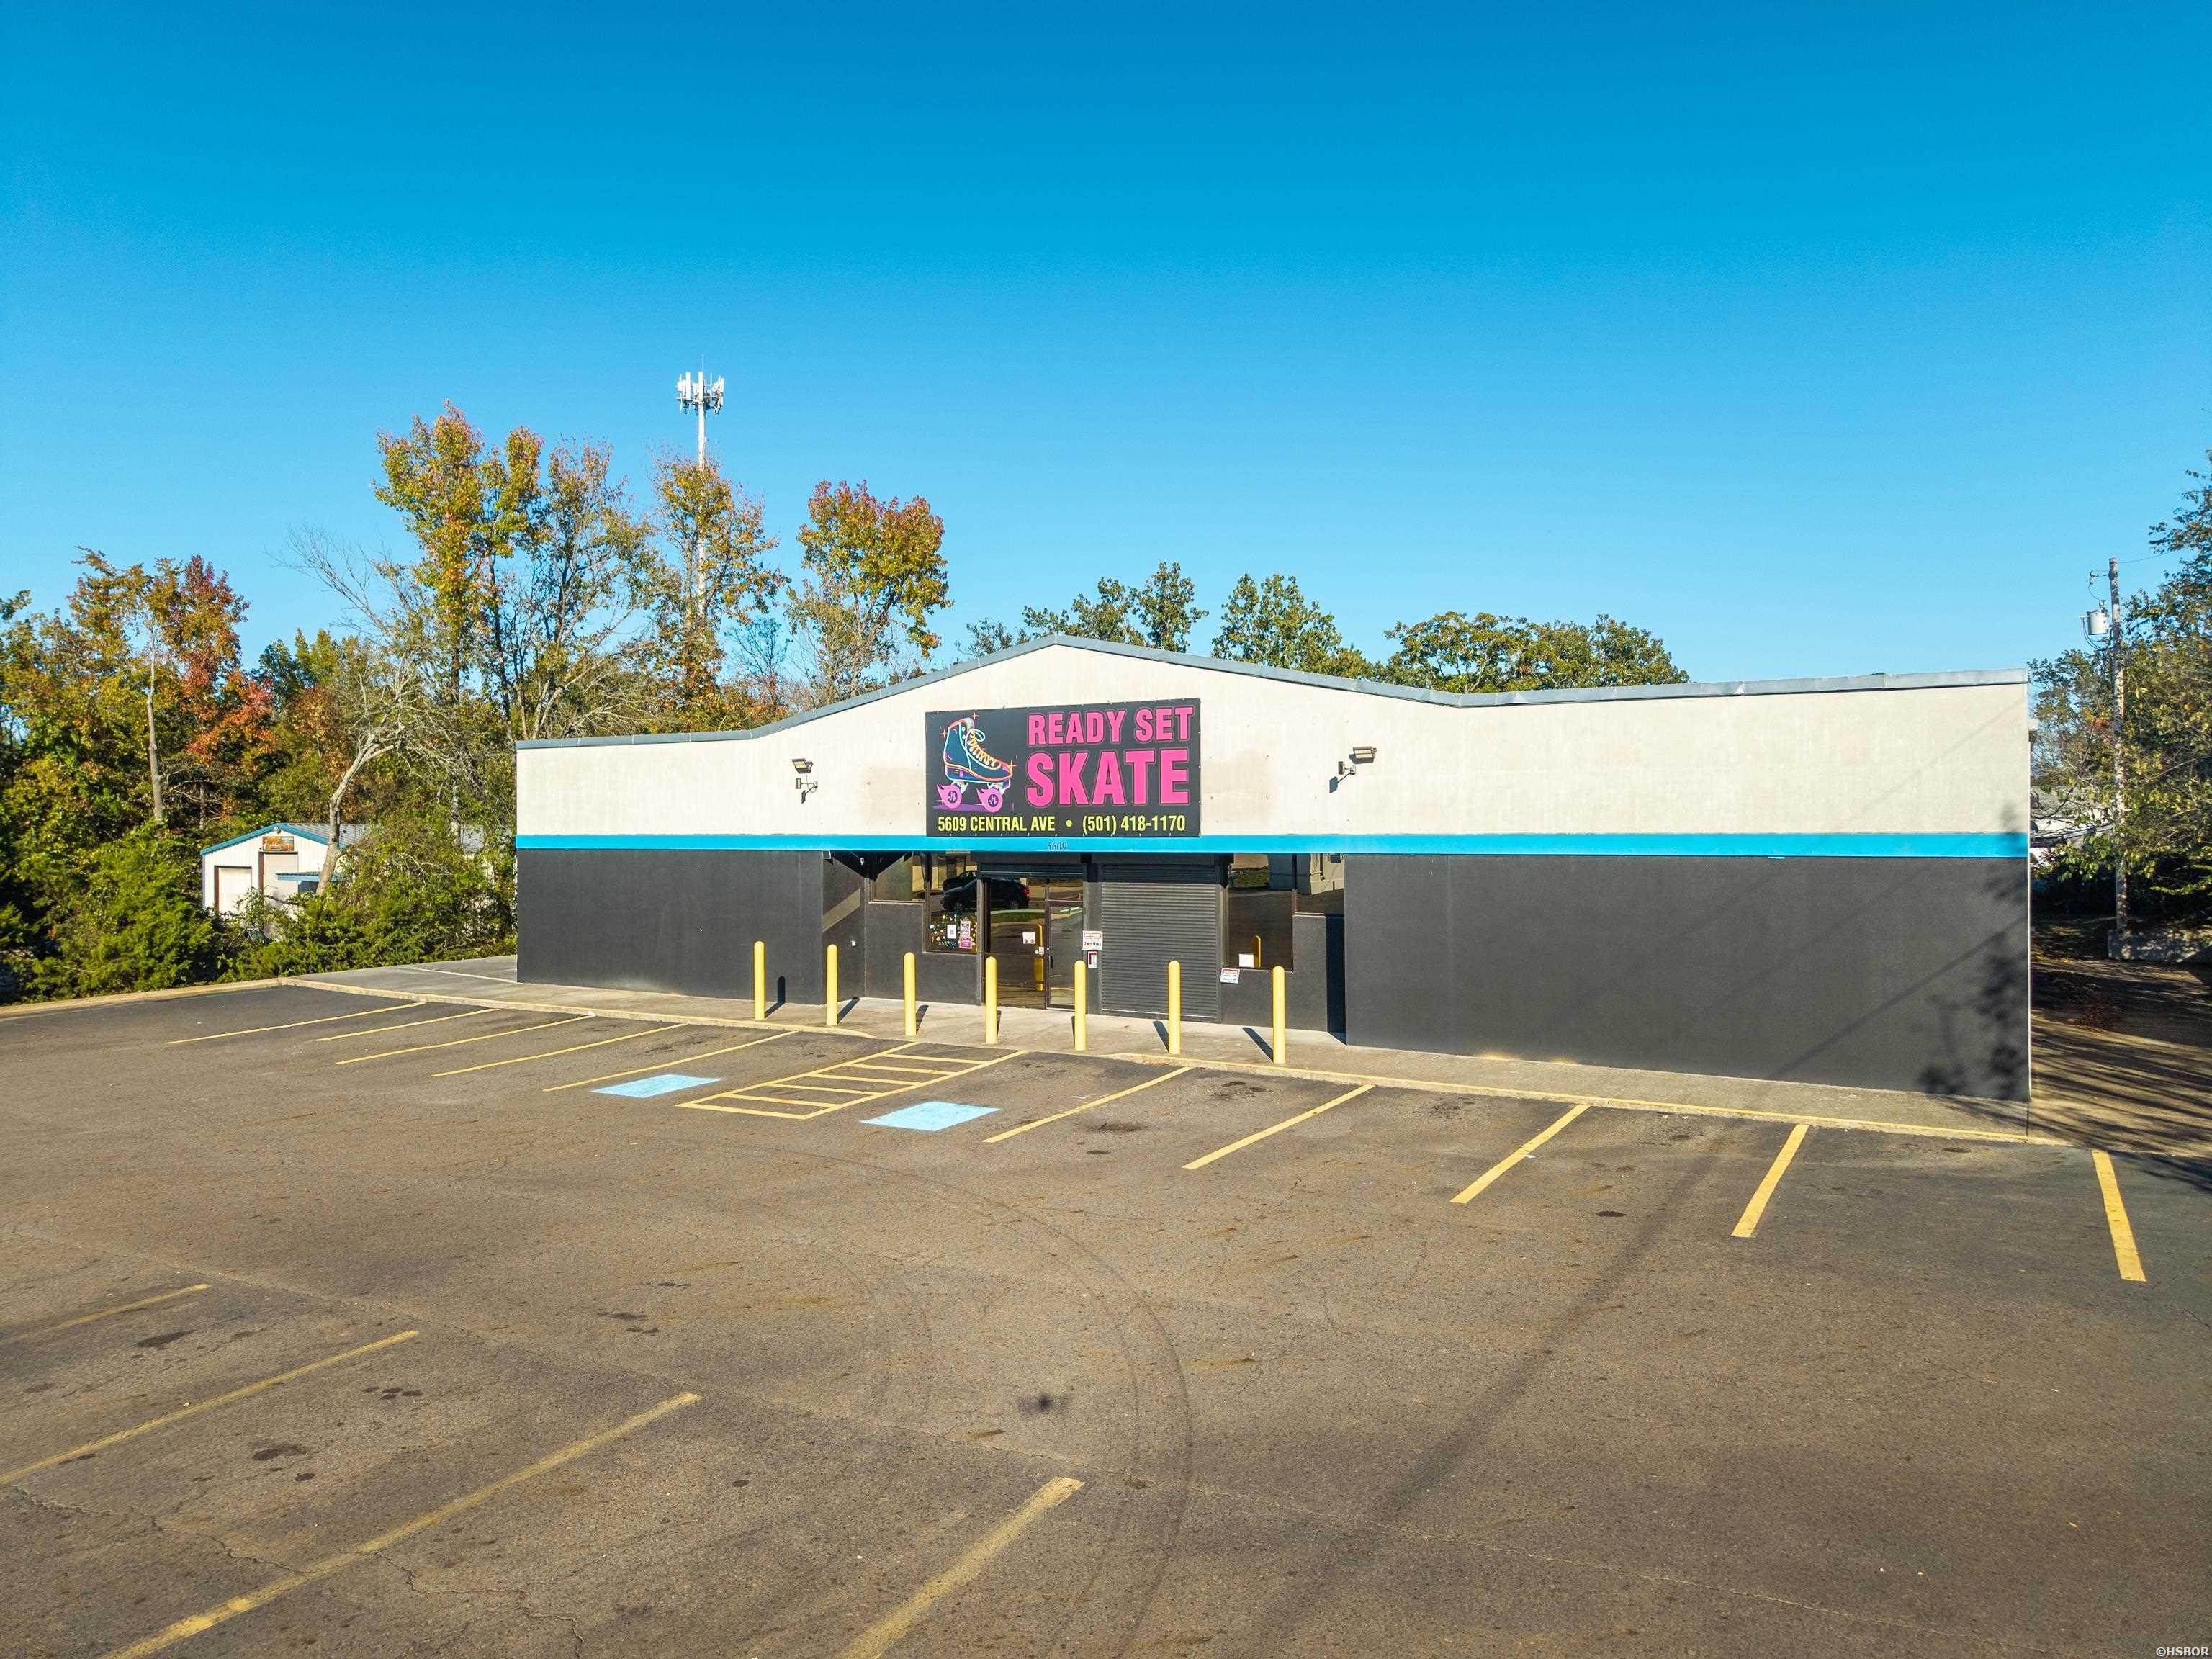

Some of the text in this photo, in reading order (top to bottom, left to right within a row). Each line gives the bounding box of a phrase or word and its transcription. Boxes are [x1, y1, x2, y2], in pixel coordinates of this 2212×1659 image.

[1028, 706, 1194, 745] READY SET
[1026, 749, 1190, 807] SKATE
[938, 815, 1186, 835] 5609 CENTRAL AVE (501) 418-1170
